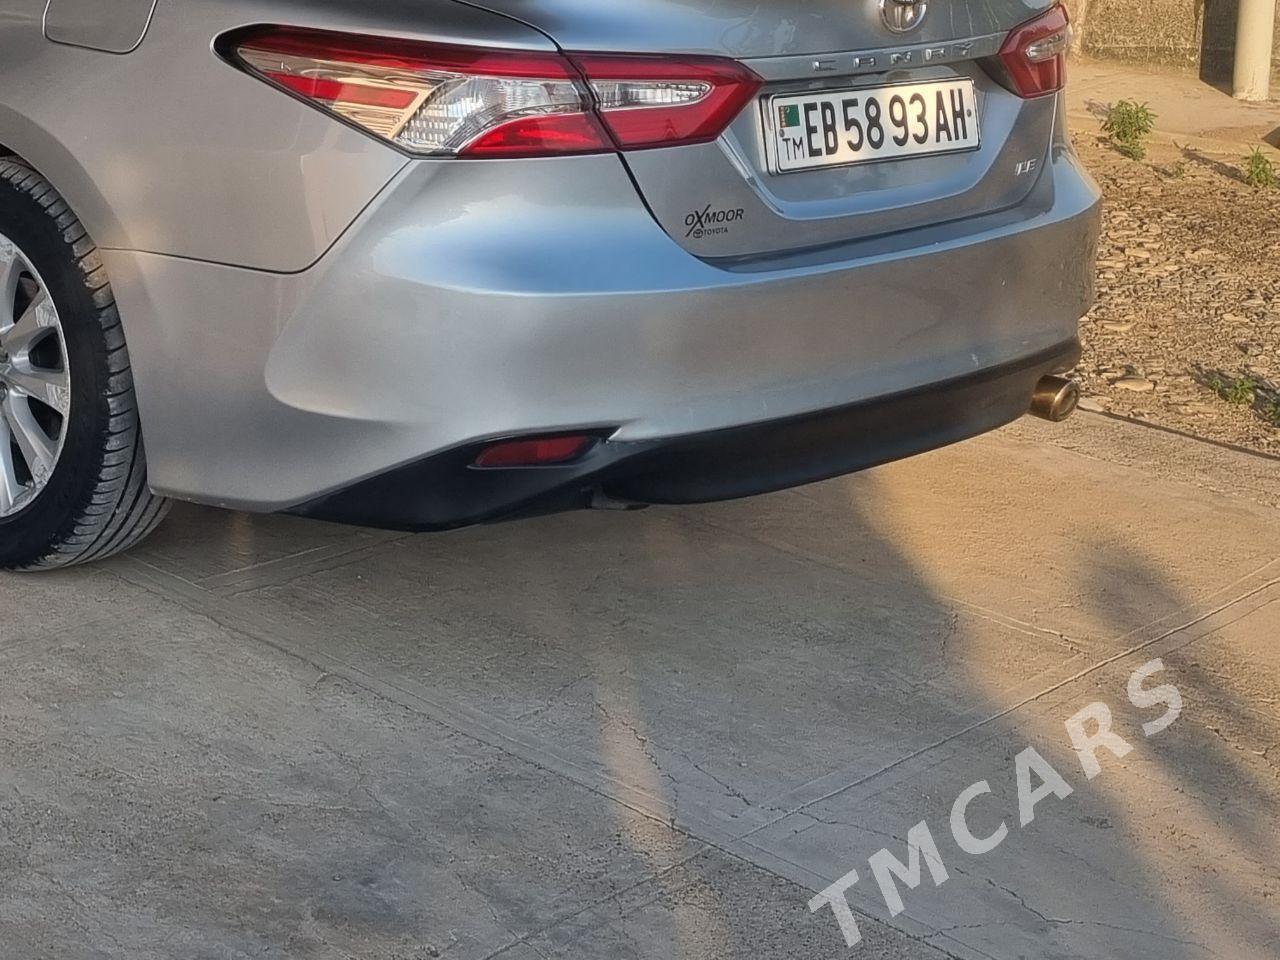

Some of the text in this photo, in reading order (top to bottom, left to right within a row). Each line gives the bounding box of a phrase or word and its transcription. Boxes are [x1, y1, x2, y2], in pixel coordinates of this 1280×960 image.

[782, 136, 805, 161] TM
[685, 204, 744, 237] OXMOOR
[704, 227, 729, 236] TOYOTA
